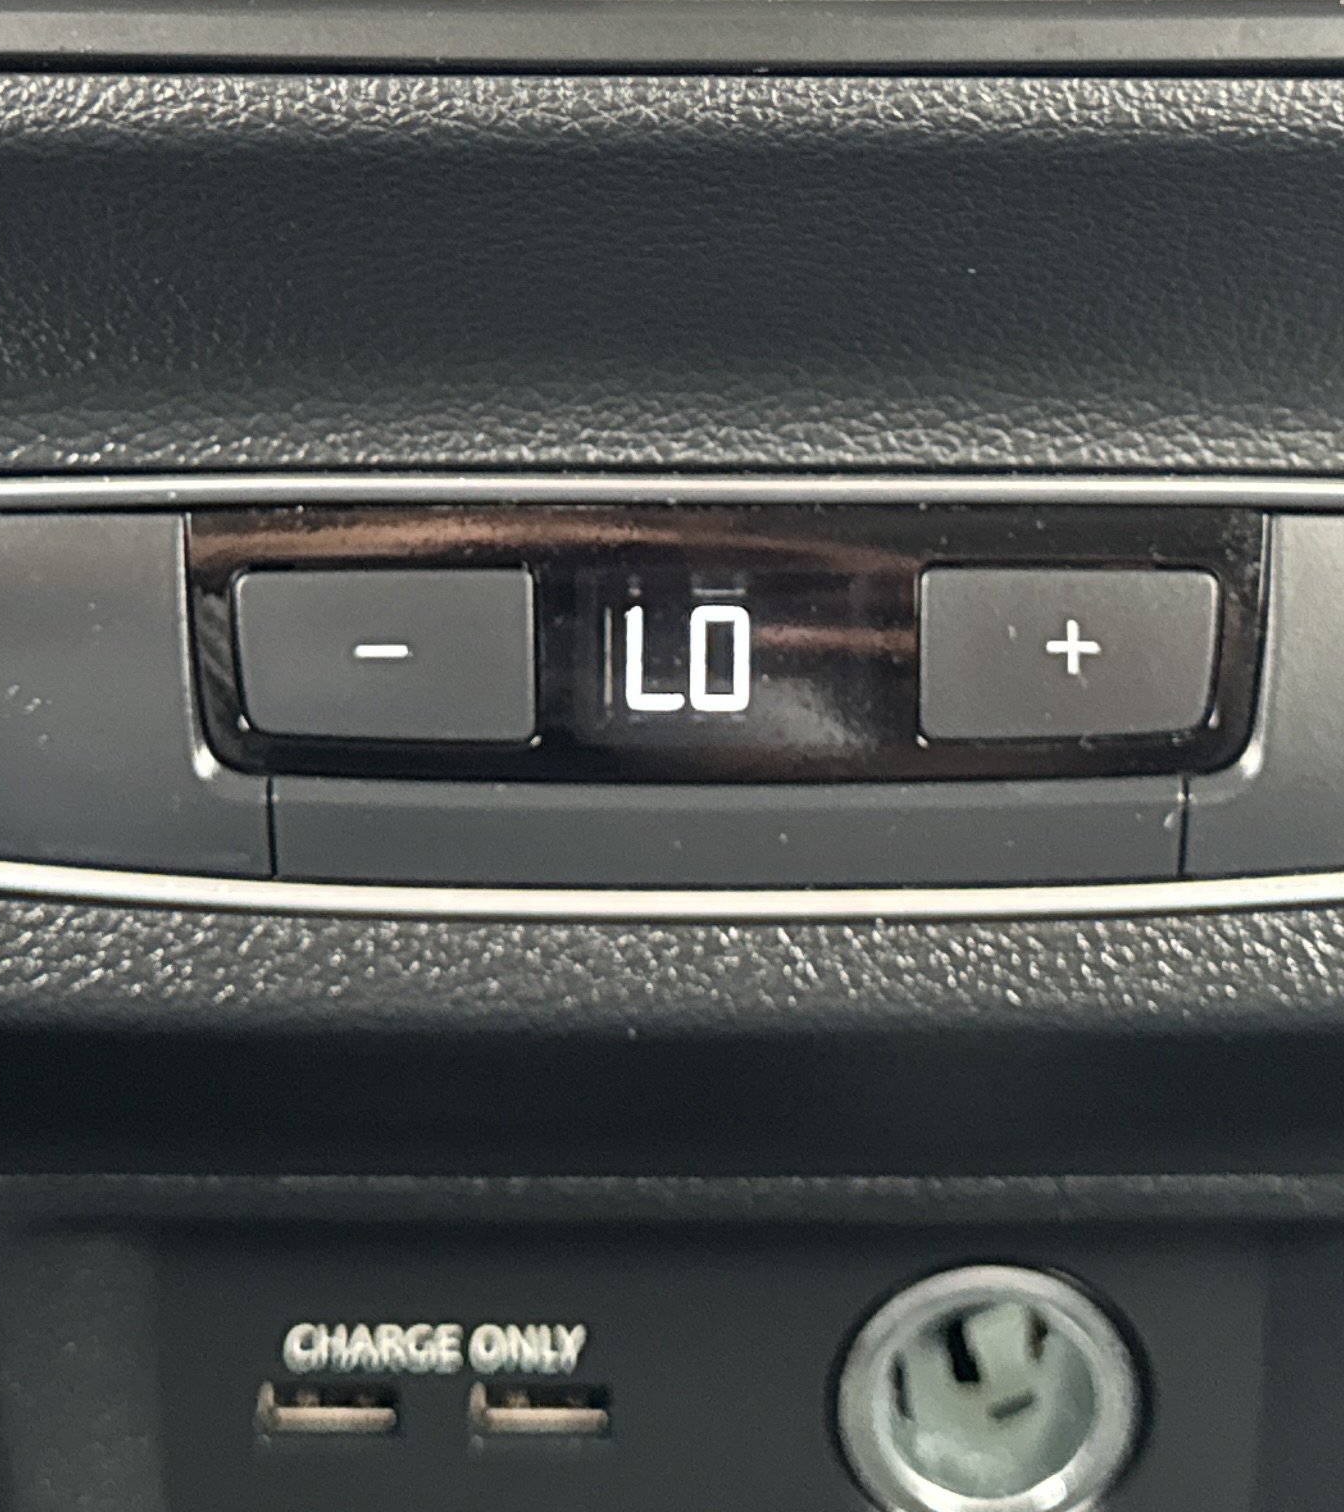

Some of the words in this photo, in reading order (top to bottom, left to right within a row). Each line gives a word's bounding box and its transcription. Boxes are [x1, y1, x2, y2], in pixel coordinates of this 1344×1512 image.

[623, 604, 751, 713] LO
[283, 1321, 463, 1375] CHARGE
[468, 1322, 587, 1375] ONLY
